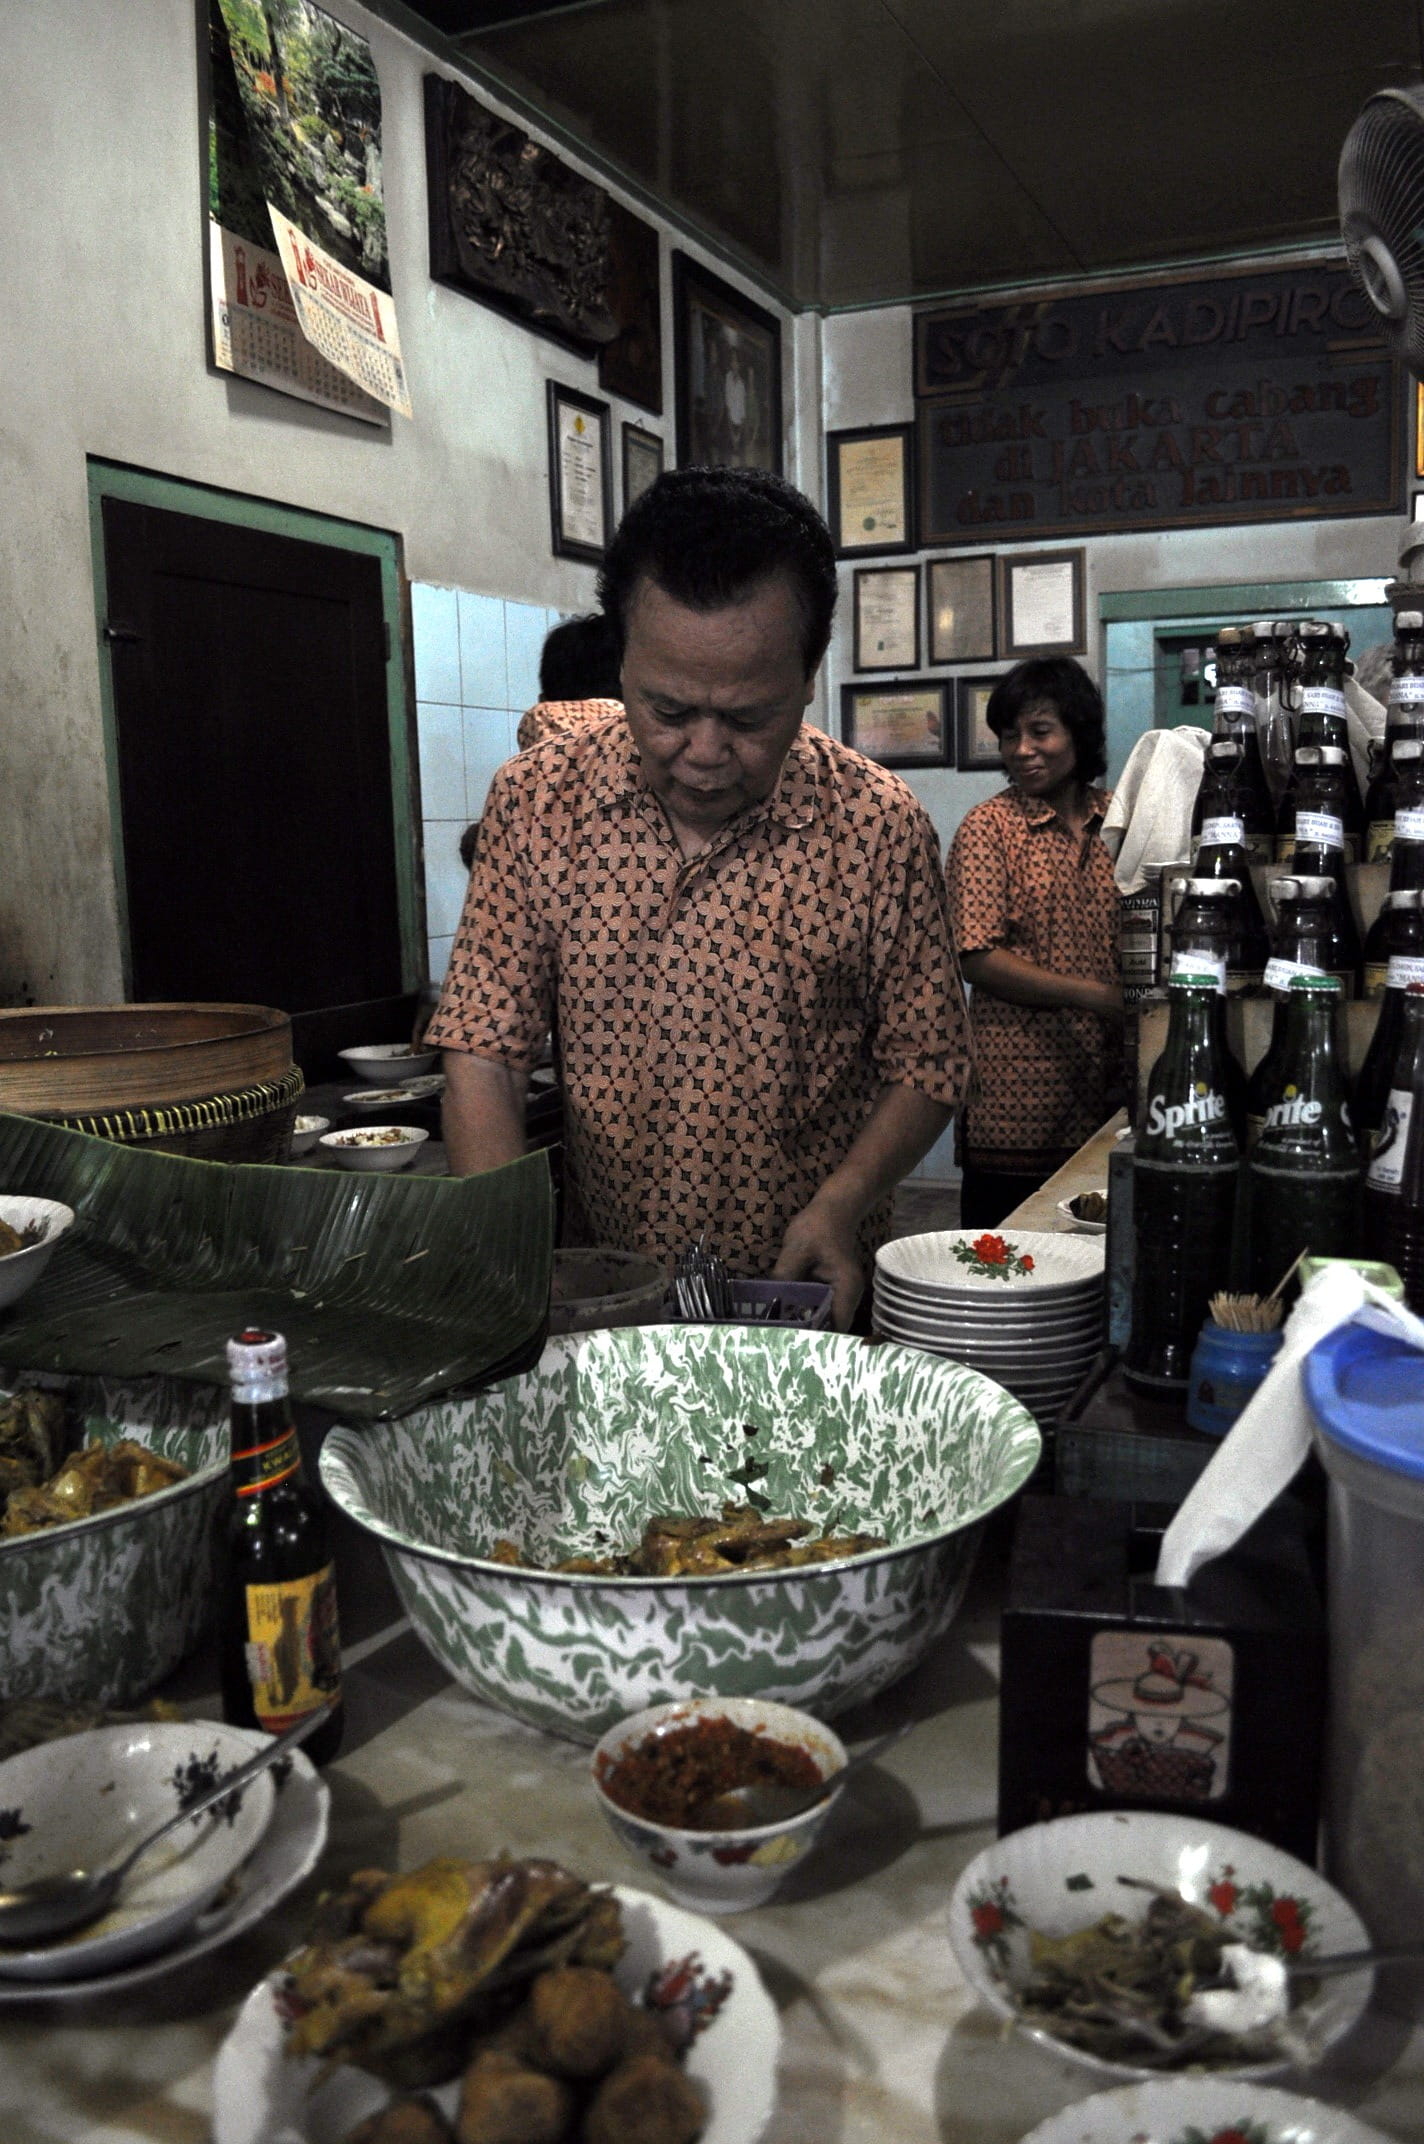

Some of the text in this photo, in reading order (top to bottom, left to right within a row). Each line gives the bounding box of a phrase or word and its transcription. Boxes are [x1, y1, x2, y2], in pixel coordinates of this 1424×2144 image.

[932, 287, 1374, 375] SOTO KADIPIRO
[938, 378, 1379, 446] tidak buka cabang
[994, 420, 1300, 485] di JAKARTA
[956, 463, 1353, 525] dan kota lainnya
[1146, 1085, 1226, 1138] Sprite
